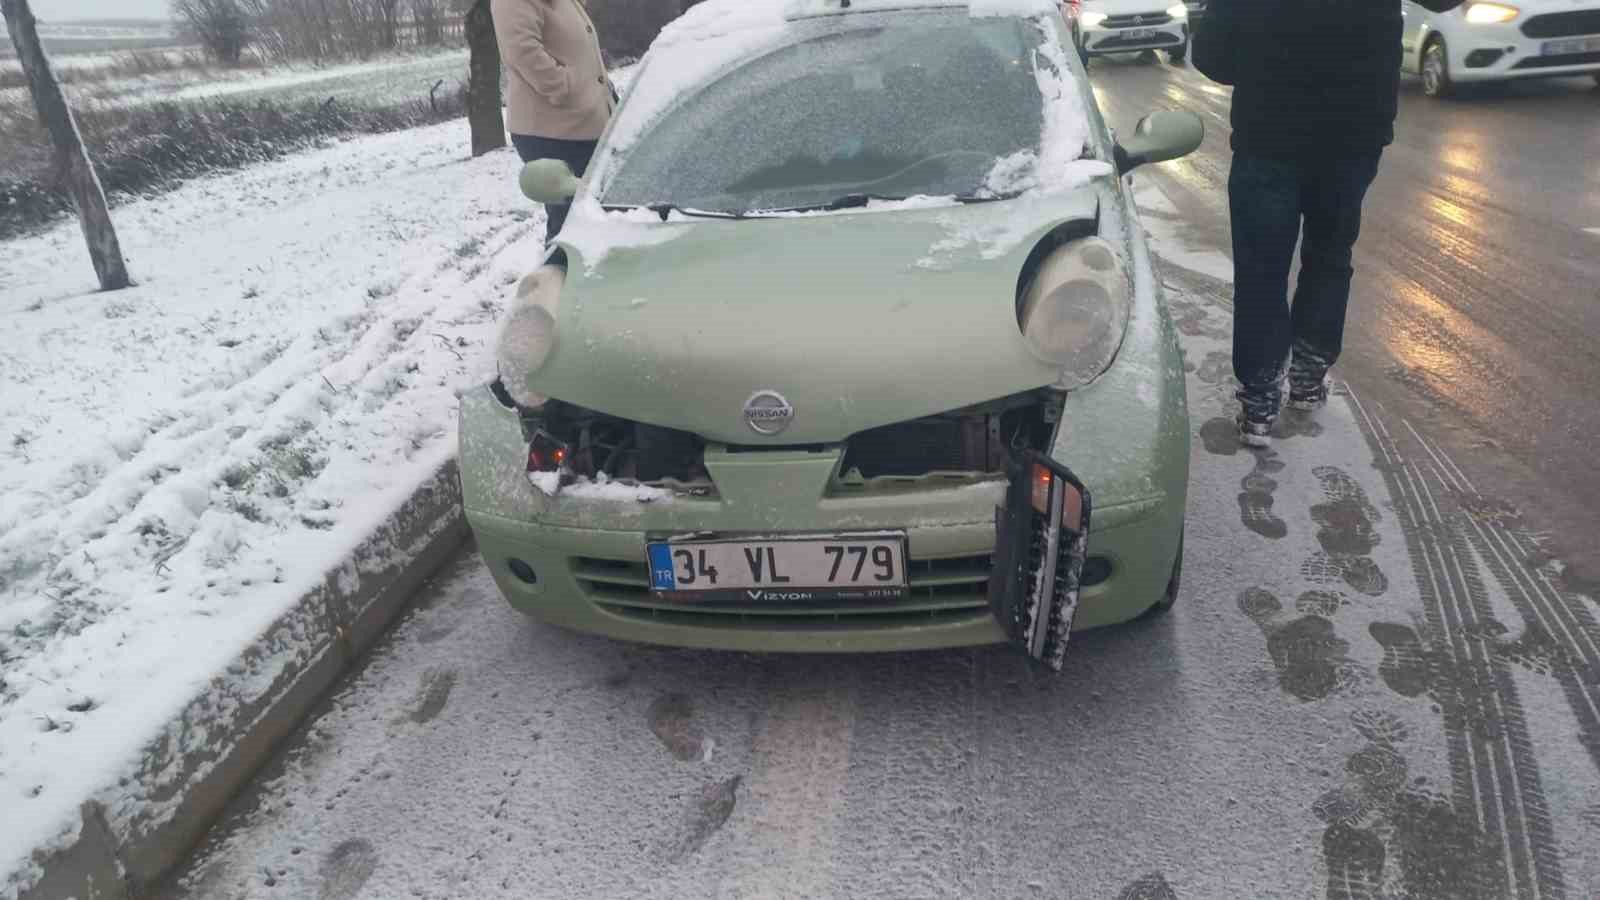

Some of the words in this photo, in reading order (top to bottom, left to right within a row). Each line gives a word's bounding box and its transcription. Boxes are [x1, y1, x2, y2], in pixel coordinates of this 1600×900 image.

[745, 407, 789, 418] NISSAN
[656, 569, 673, 581] TR
[674, 549, 719, 584] 34
[744, 547, 790, 582] VL
[824, 545, 894, 582] 779
